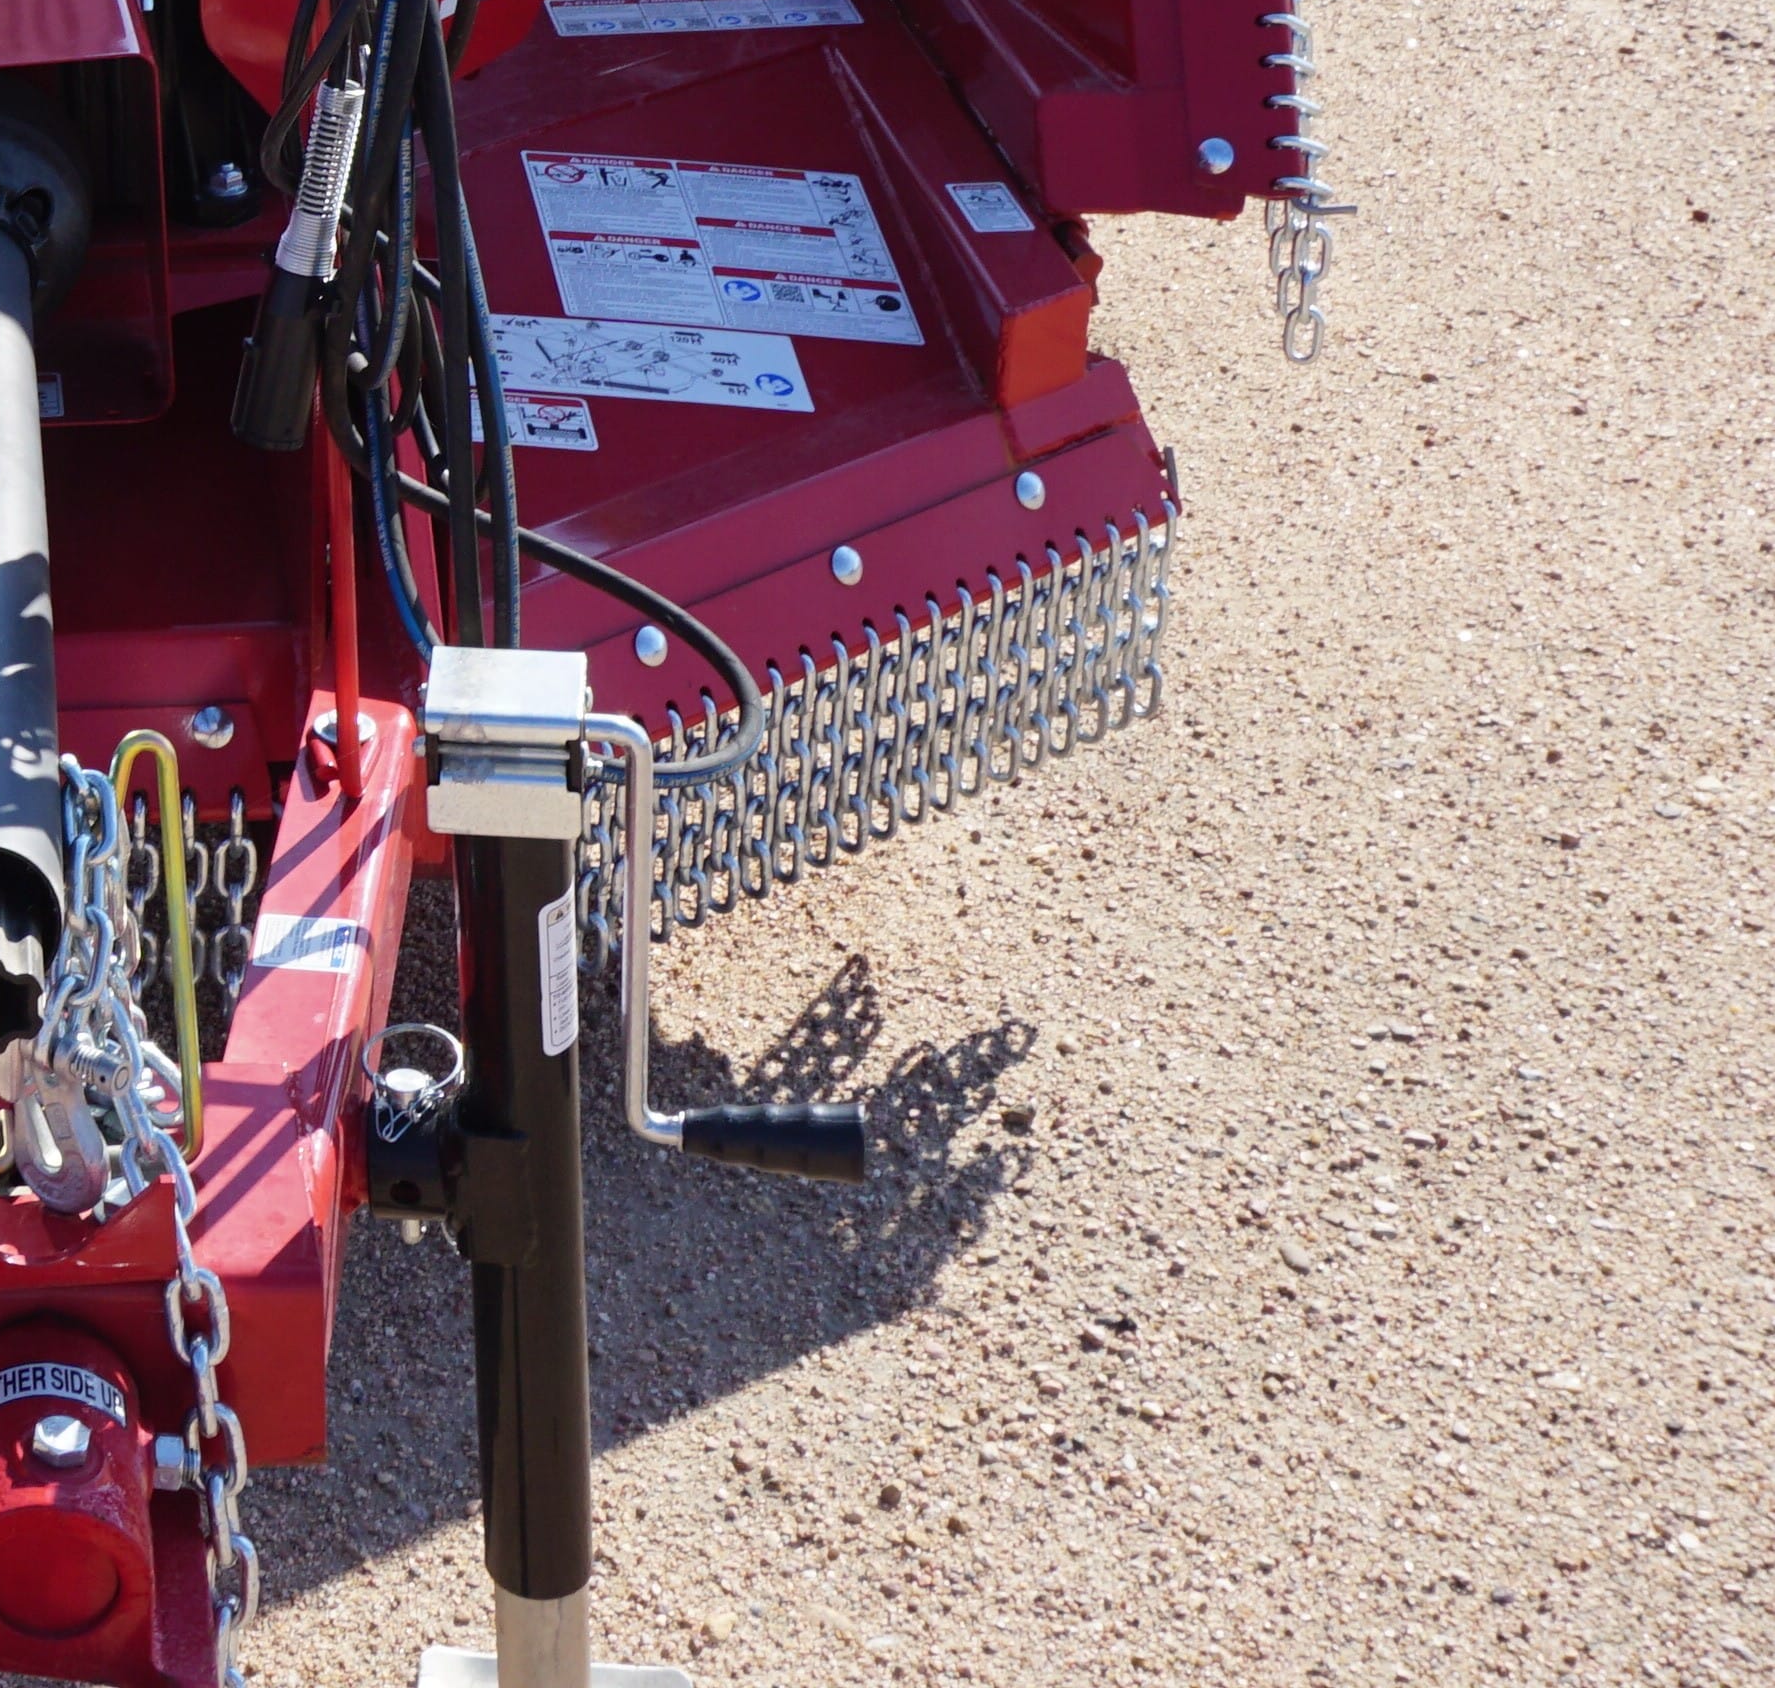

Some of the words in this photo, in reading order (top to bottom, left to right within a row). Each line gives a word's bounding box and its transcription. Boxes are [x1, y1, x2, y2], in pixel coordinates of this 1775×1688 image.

[380, 1, 398, 57] MNFLEX
[401, 138, 412, 193] MNFLEX
[582, 157, 635, 167] DANGER
[721, 167, 775, 178] DANGER
[745, 222, 802, 233] DANGER
[607, 235, 661, 245] DANGER
[788, 274, 843, 286] DANGER
[50, 1367, 96, 1399] SIDE
[101, 1384, 124, 1415] UP
